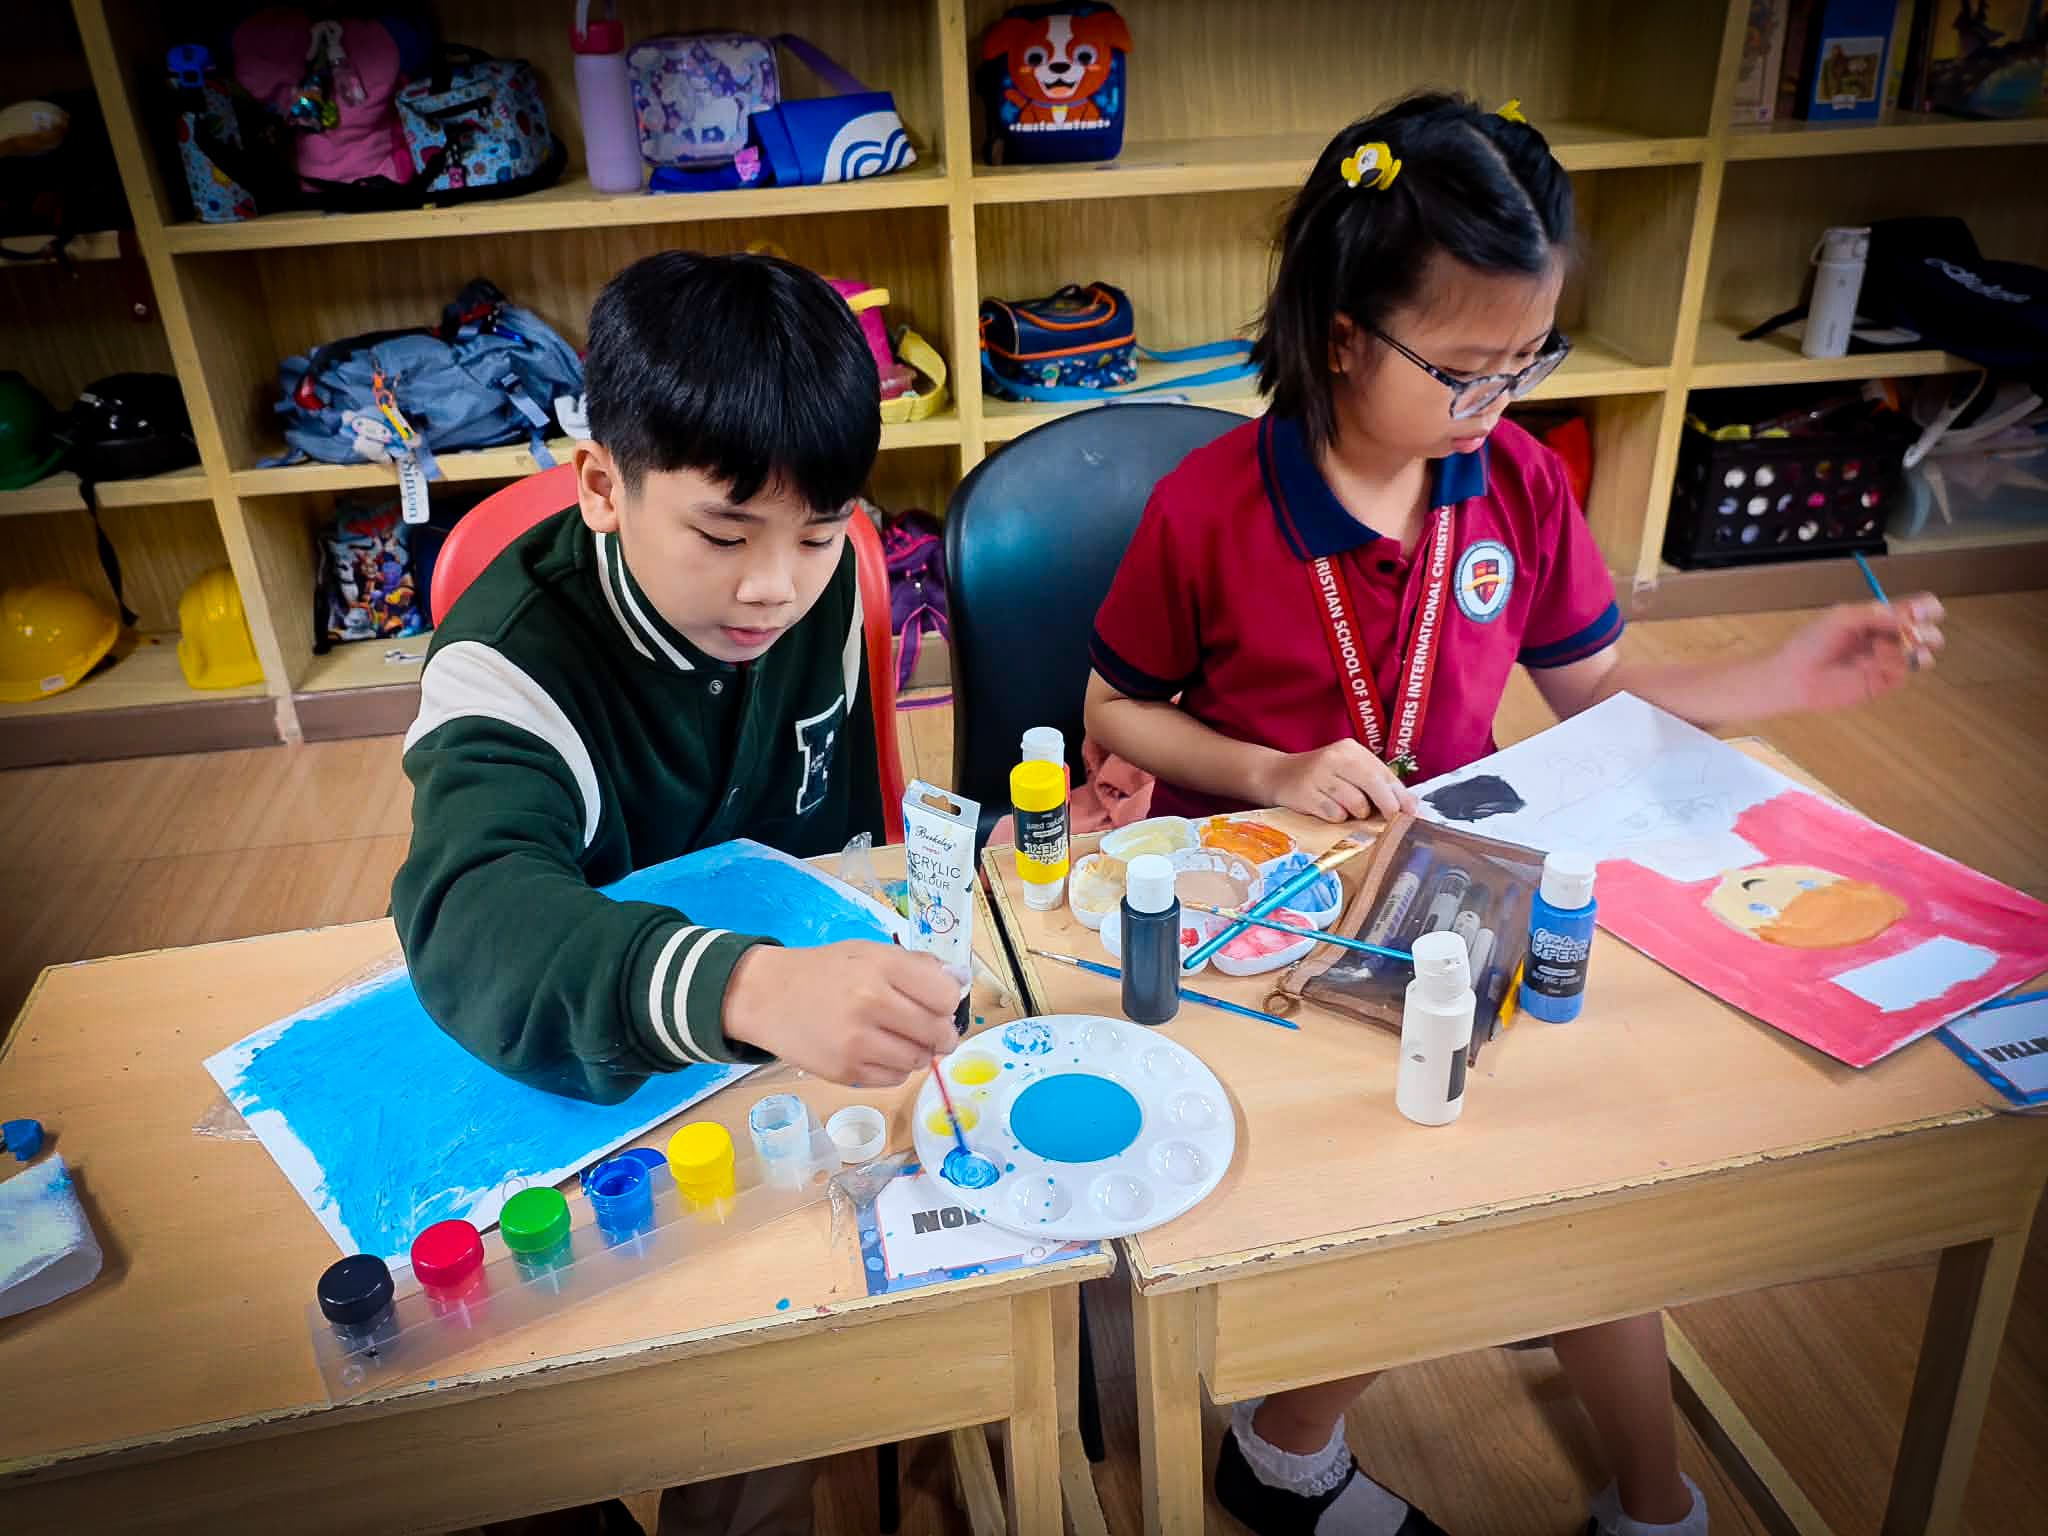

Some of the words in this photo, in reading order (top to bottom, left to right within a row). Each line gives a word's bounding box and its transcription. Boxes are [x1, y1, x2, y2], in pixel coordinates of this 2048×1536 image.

[1334, 620, 1361, 680] SCHOOL
[1395, 702, 1418, 755] EADERS
[1408, 580, 1442, 700] INTERNATIONAL
[1351, 678, 1369, 698] OF
[1357, 698, 1384, 756] MANILA
[913, 825, 954, 852] Berkeley
[907, 850, 961, 879] ACRYLIC
